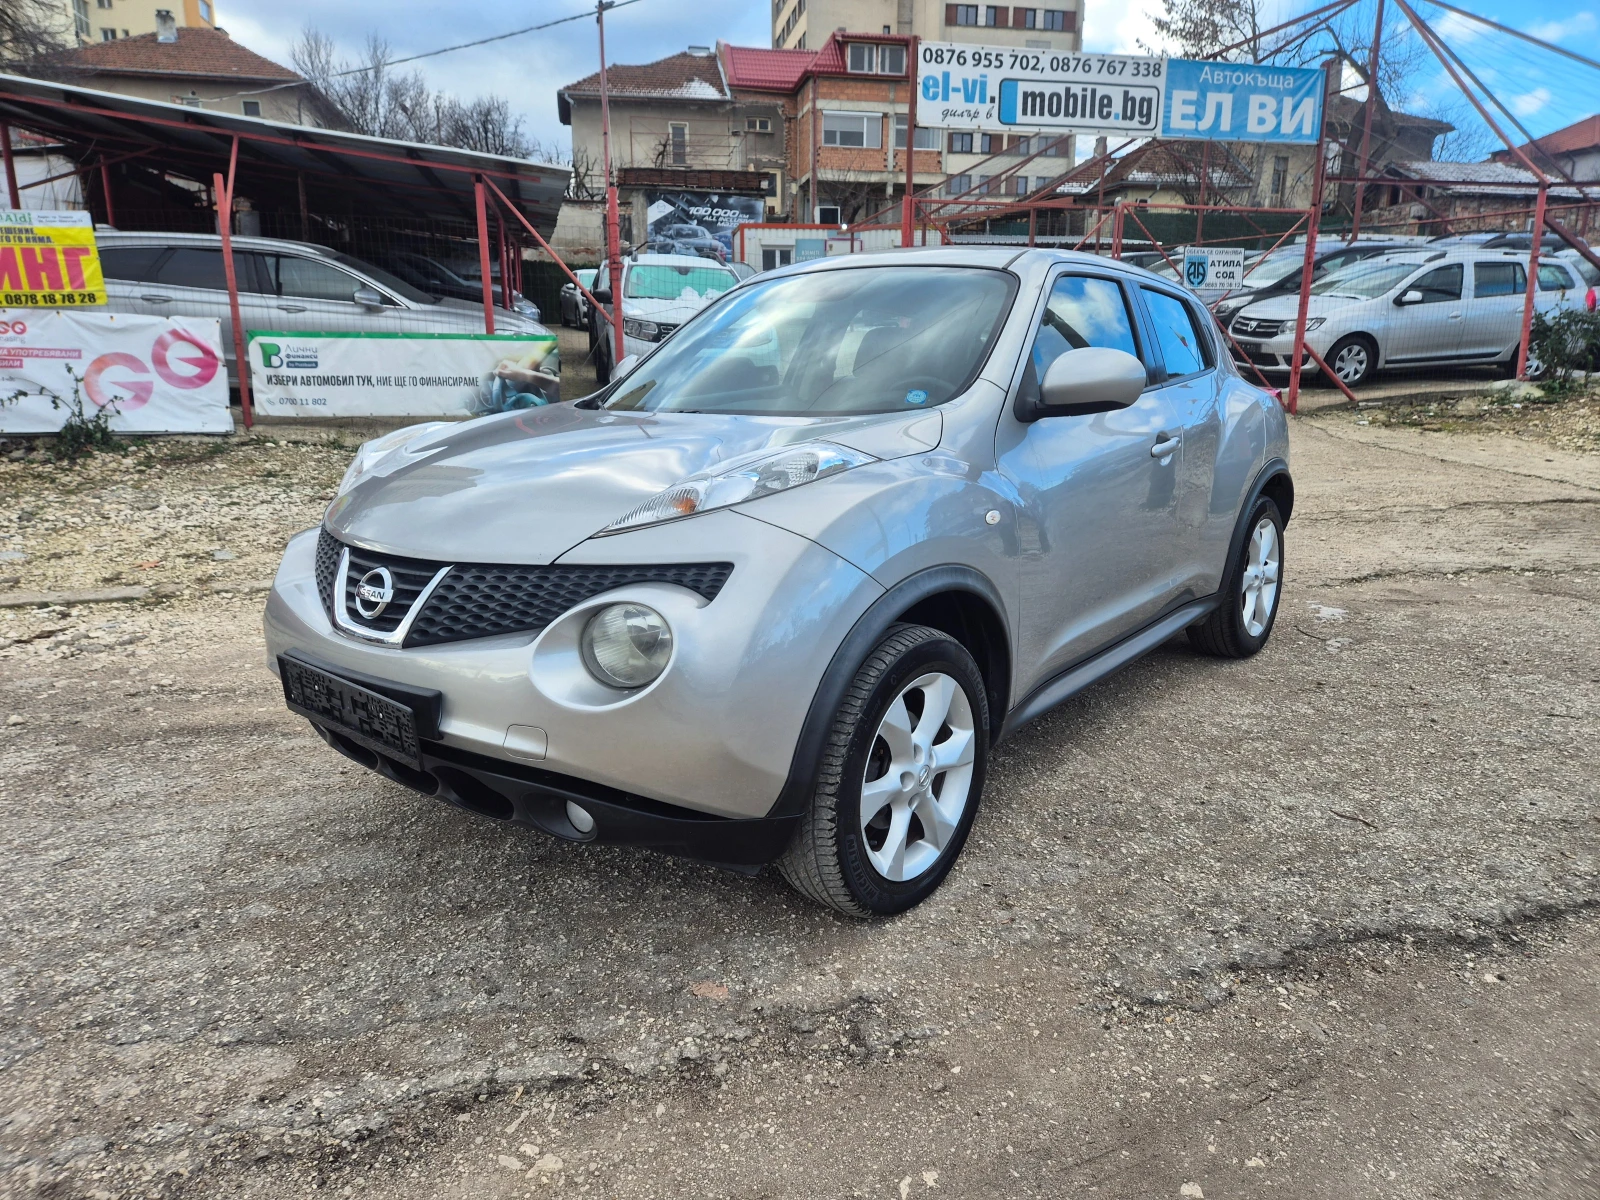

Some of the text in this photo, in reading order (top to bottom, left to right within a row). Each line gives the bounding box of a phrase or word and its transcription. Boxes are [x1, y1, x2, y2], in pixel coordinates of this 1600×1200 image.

[922, 47, 1161, 78] 0876 955 702, 0876 767 338
[1200, 65, 1294, 91] Автокъща
[1021, 86, 1153, 125] mobile.bg
[1170, 89, 1315, 135] ЕЛ ВИ
[941, 108, 980, 121] дилър
[689, 206, 711, 215] 100
[712, 208, 739, 217] 000
[1215, 271, 1235, 280] СОД
[4, 293, 97, 305] 0878 18 78 28
[10, 349, 79, 357] УПОТРЕБЯВАНИ
[285, 344, 318, 353] Лични
[266, 374, 479, 388] ИЗБЕРИ АВТОМОБИЛ ТУК, НИЕ ЩЕ ГО ФИНАНСИРАМЕ
